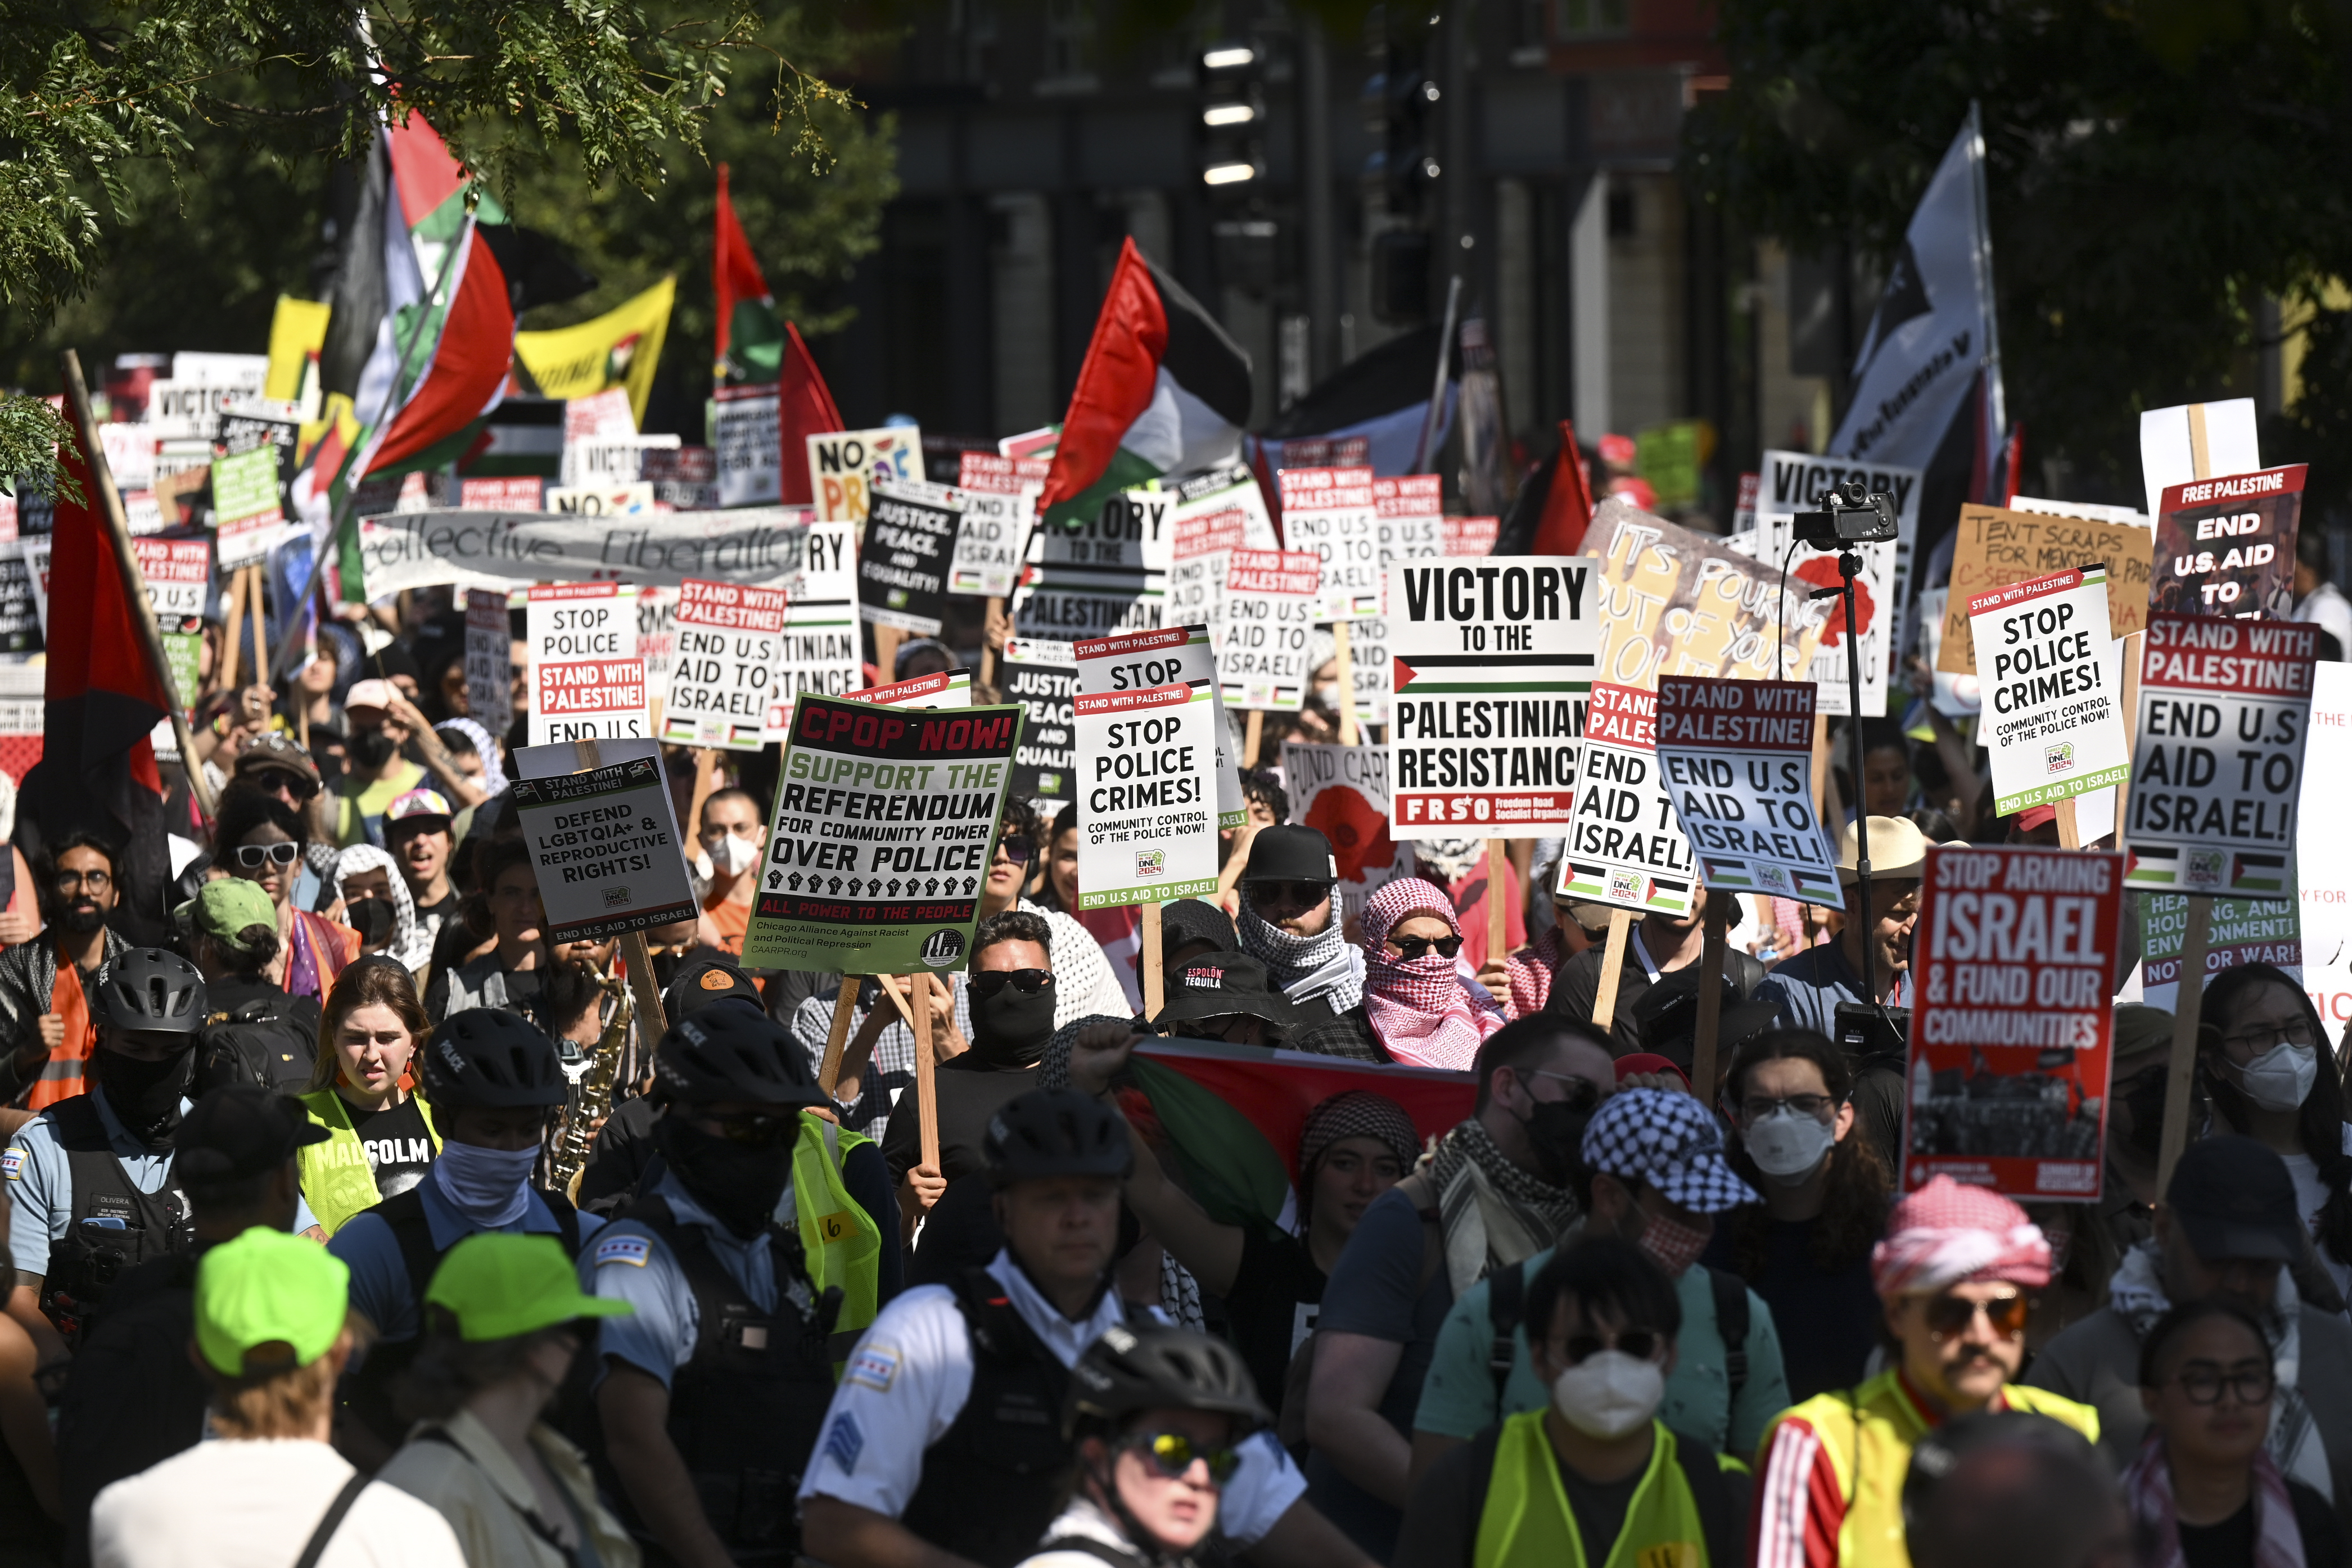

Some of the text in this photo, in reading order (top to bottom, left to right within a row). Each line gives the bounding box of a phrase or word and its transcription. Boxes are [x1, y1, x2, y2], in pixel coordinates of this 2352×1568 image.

[819, 441, 864, 472] NO
[2182, 472, 2283, 503] FREE PALESTINE
[1966, 516, 2123, 552] TENT SCRAPS
[2196, 513, 2260, 540] END
[1231, 550, 1319, 573] STAND WITH
[1986, 544, 2028, 564] FOR
[2174, 543, 2275, 577] U.S. AID
[862, 561, 941, 593] EQUALITY!
[1229, 570, 1316, 593] PALESTINE!
[1972, 575, 2074, 609] STAND WITH PALESTINE!
[2201, 582, 2241, 604] TO
[681, 582, 784, 609] STAND WITH
[1403, 567, 1587, 621] VICTORY
[1691, 557, 1831, 638] POURING
[553, 609, 608, 630] STOP
[678, 600, 782, 630] PALESTINE!
[2003, 603, 2074, 644] STOP
[544, 633, 619, 656] POLICE
[679, 632, 770, 659] END U.S
[1078, 632, 1180, 656] STAND WITH PALESTINE!
[1460, 625, 1532, 651] TO THE
[1665, 606, 1800, 680] OF YOUR
[2150, 621, 2315, 657] STAND WITH
[1996, 631, 2091, 681] POLICE
[2146, 652, 2310, 692] PALESTINE!
[542, 663, 642, 687] STAND WITH
[675, 658, 768, 689] AID TO
[1994, 662, 2101, 714] CRIMES!
[543, 685, 643, 710] PALESTINE!
[672, 686, 764, 717] ISRAEL!
[874, 679, 941, 701] WITH PALESTINE!
[1078, 689, 1184, 710] STAND WITH PALESTINE!
[1660, 683, 1743, 709] STAND
[1754, 688, 1811, 713] WITH
[801, 707, 1012, 751] CPOP NOW!
[1398, 700, 1589, 738] PALESTINIAN
[1660, 712, 1809, 744] PALESTINE!
[1996, 697, 2111, 736] COMMUNITY CONTROL
[2001, 709, 2110, 747] OF THE POLICE NOW!
[2148, 701, 2298, 744] END U.S
[2315, 711, 2345, 726] THE
[1107, 717, 1181, 749] STOP
[545, 766, 624, 789] STAND WITH
[789, 752, 1003, 790] SUPPORT THE
[1096, 746, 1194, 782] POLICE
[1587, 749, 1646, 785] END
[1667, 756, 1799, 794] END U.S
[2139, 745, 2294, 794] AID TO
[552, 778, 622, 799] PALESTINE!
[782, 784, 996, 821] REFERENDUM
[1089, 777, 1202, 814] CRIMES!
[1495, 797, 1554, 808] Freedom Road
[1578, 785, 1640, 823] AID
[1999, 767, 2128, 812] END U.S AID TO ISRAEL!
[554, 804, 632, 830] DEFEND
[1088, 811, 1208, 833] COMMUNITY CONTROL
[1495, 809, 1532, 820] Socialist
[1684, 790, 1810, 831] AID TO
[2134, 793, 2288, 841] ISRAEL!
[539, 817, 657, 849] LGBTQIA+ &
[778, 816, 990, 842] FOR COMMUNITY POWER
[1091, 823, 1205, 844] OF THE POLICE NOW!
[1690, 823, 1825, 864] ISRAEL!
[540, 833, 668, 866] REPRODUCTIVE
[771, 837, 985, 873] OVER POLICE
[1574, 822, 1692, 871] ISRAEL!
[562, 854, 651, 883] RIGHTS!
[1139, 866, 1161, 875] 2024
[1935, 853, 2111, 894] STOP ARMING
[760, 899, 972, 919] ALL POWER TO THE PEOPLE
[1083, 881, 1216, 906] END U.S AID TO ISRAEL!
[2315, 890, 2346, 903] FOR
[556, 929, 580, 940] END
[607, 921, 626, 932] AID
[630, 918, 645, 927] TO
[649, 908, 693, 923] ISRAEL!
[757, 921, 797, 932] Chicago
[799, 925, 838, 934] Alliance
[840, 929, 877, 938] Against
[1930, 893, 2105, 965] ISRAEL
[751, 946, 807, 958] CAARPR.org
[775, 936, 814, 945] Political
[816, 939, 871, 949] Repression
[2240, 945, 2295, 963] WAR!
[1185, 977, 1220, 988] TEQUILA
[1925, 965, 2102, 1009] & FUND OUR
[1922, 1009, 2099, 1050] COMMUNITIES
[314, 1138, 429, 1172] MALCOLM
